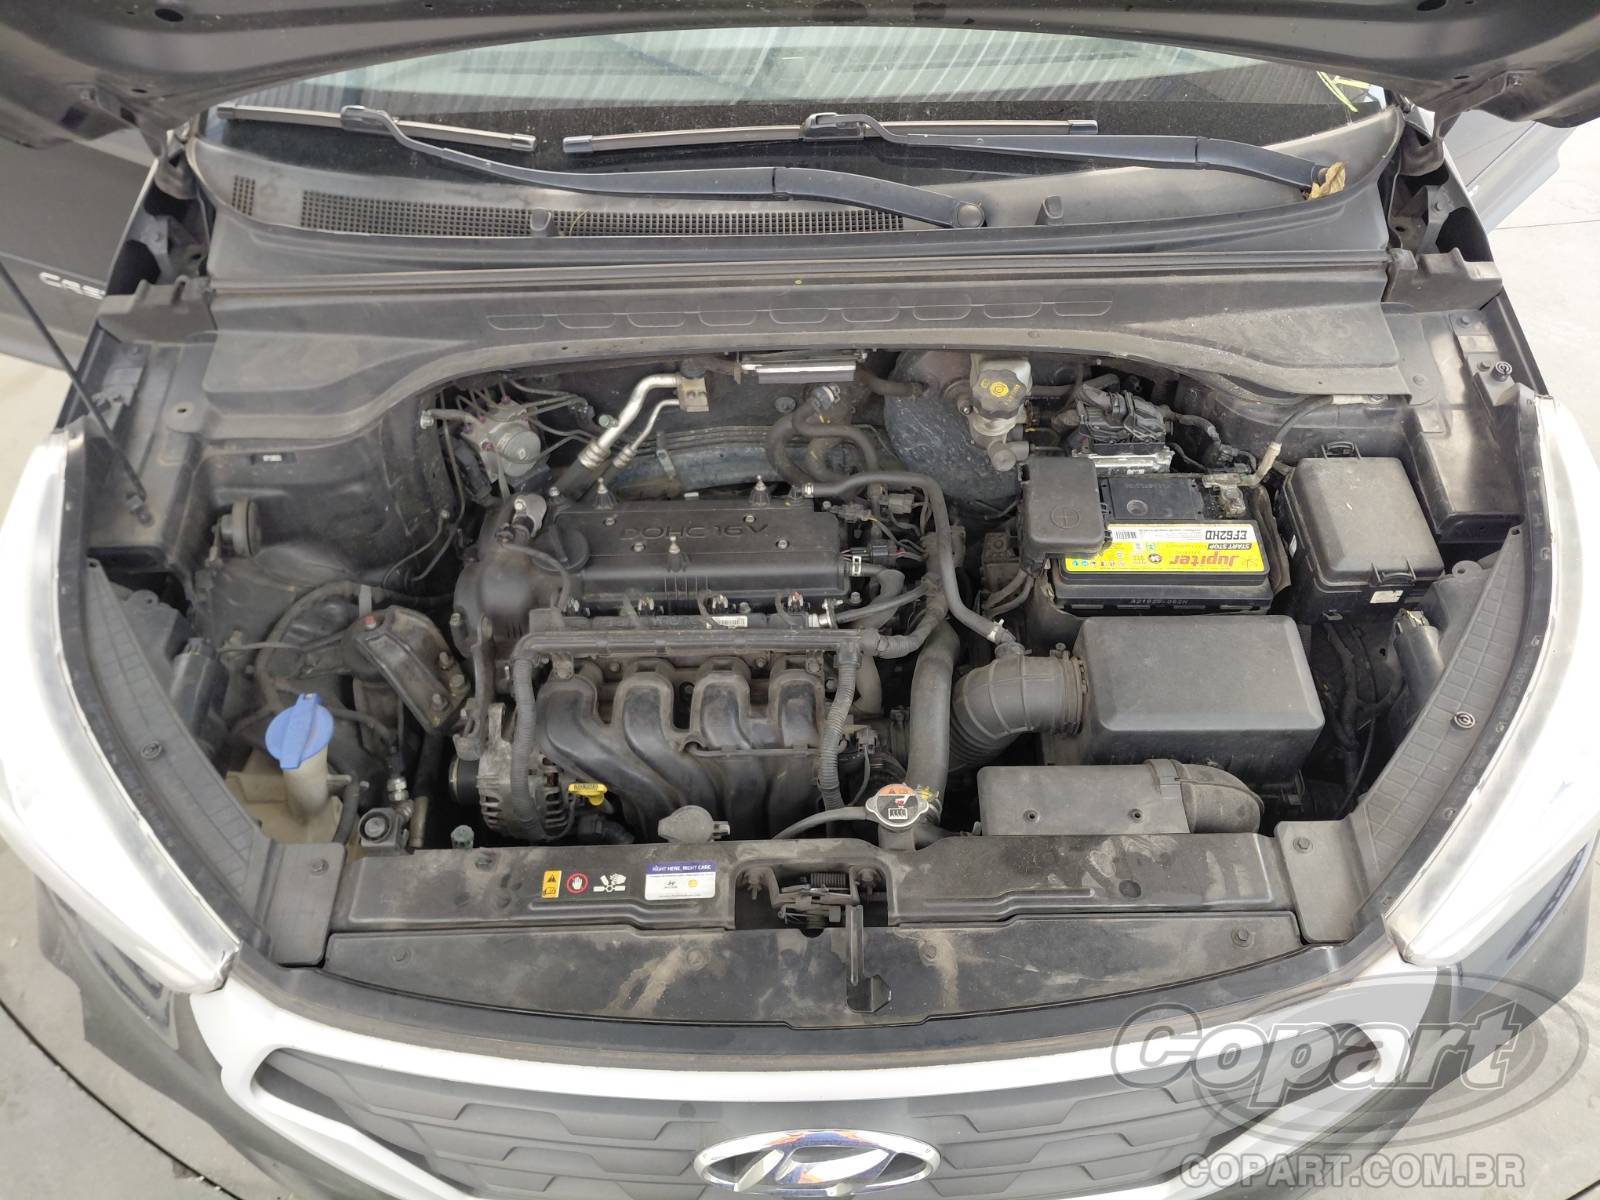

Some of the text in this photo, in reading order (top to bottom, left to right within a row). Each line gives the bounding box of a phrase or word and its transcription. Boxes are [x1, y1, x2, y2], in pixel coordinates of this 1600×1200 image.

[620, 523, 769, 540] DOHC 16V
[1205, 530, 1248, 540] EF62HD
[1169, 551, 1240, 567] Jupiter
